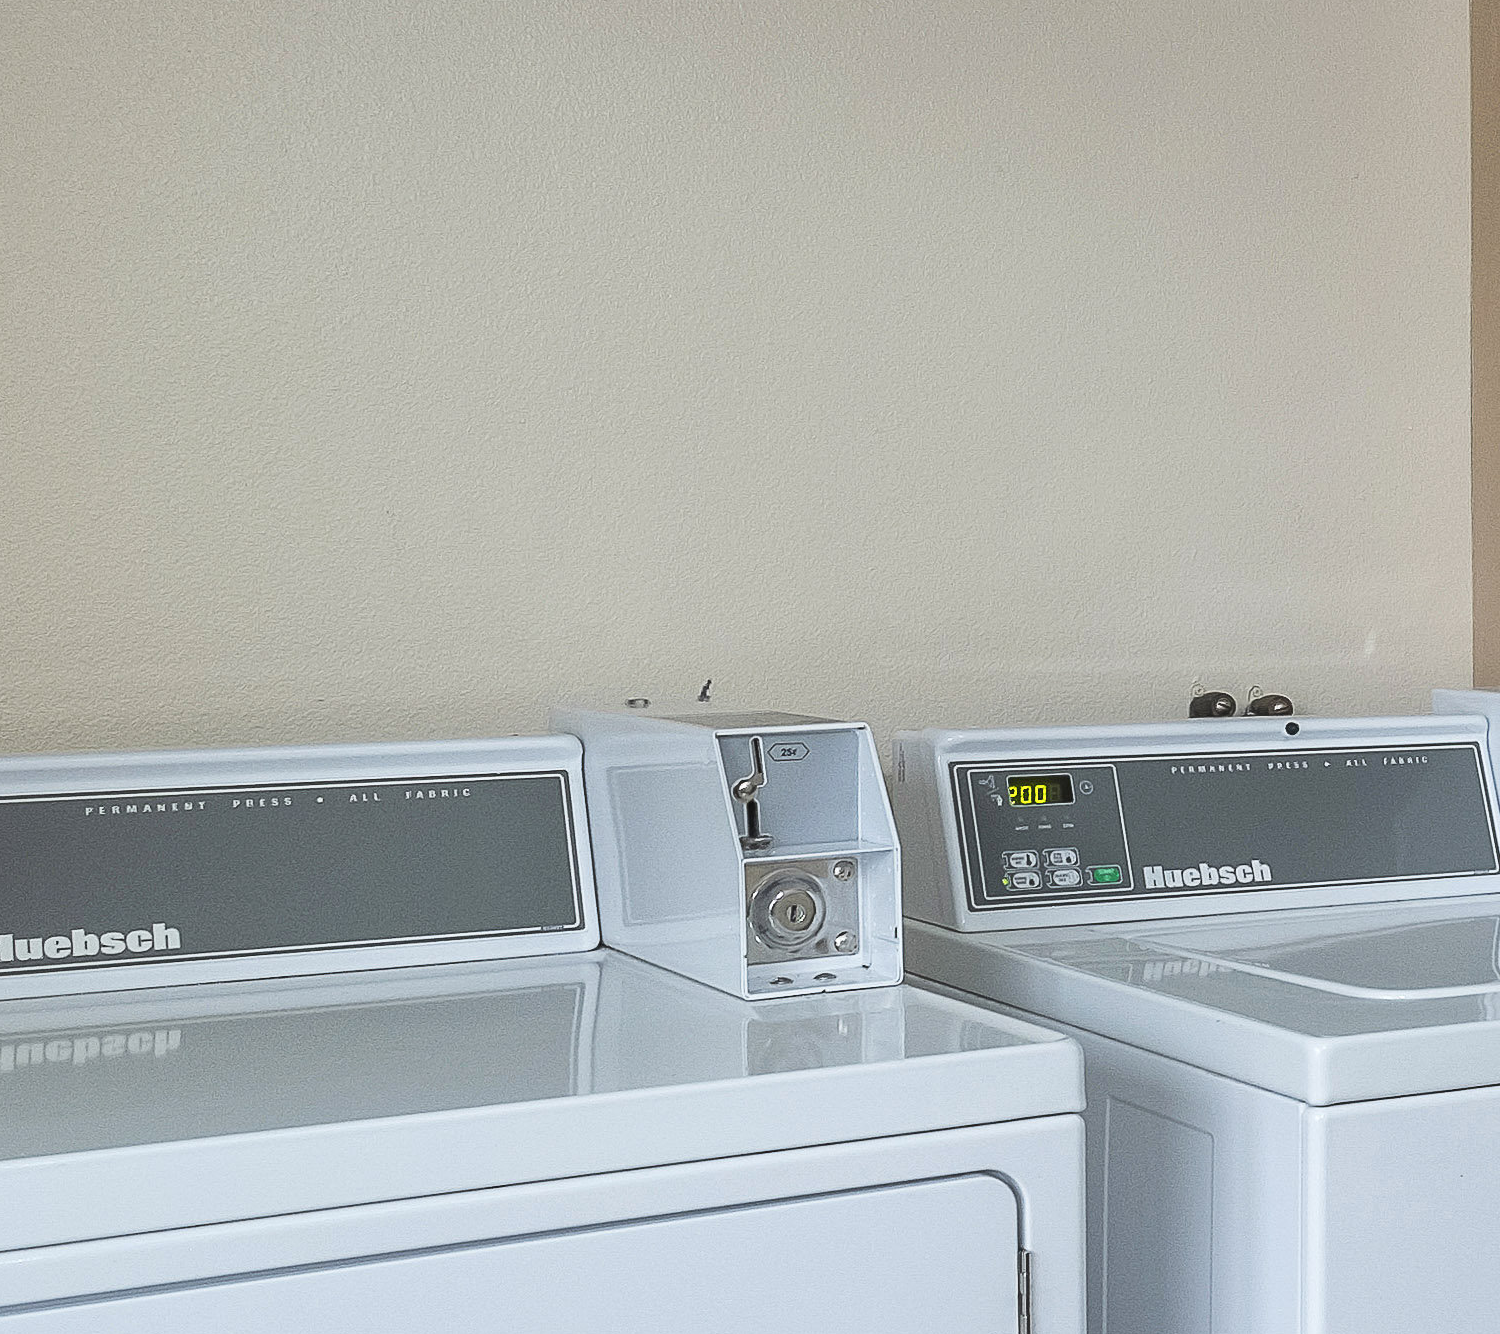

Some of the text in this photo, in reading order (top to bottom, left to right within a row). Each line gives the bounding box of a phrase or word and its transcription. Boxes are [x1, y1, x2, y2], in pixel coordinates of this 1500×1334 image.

[1170, 755, 1430, 775] PERMANENT PRESS ALL FABRIC
[85, 788, 472, 816] PERMANENT PRESS ALL FABRIC
[1143, 858, 1273, 890] Huebsch
